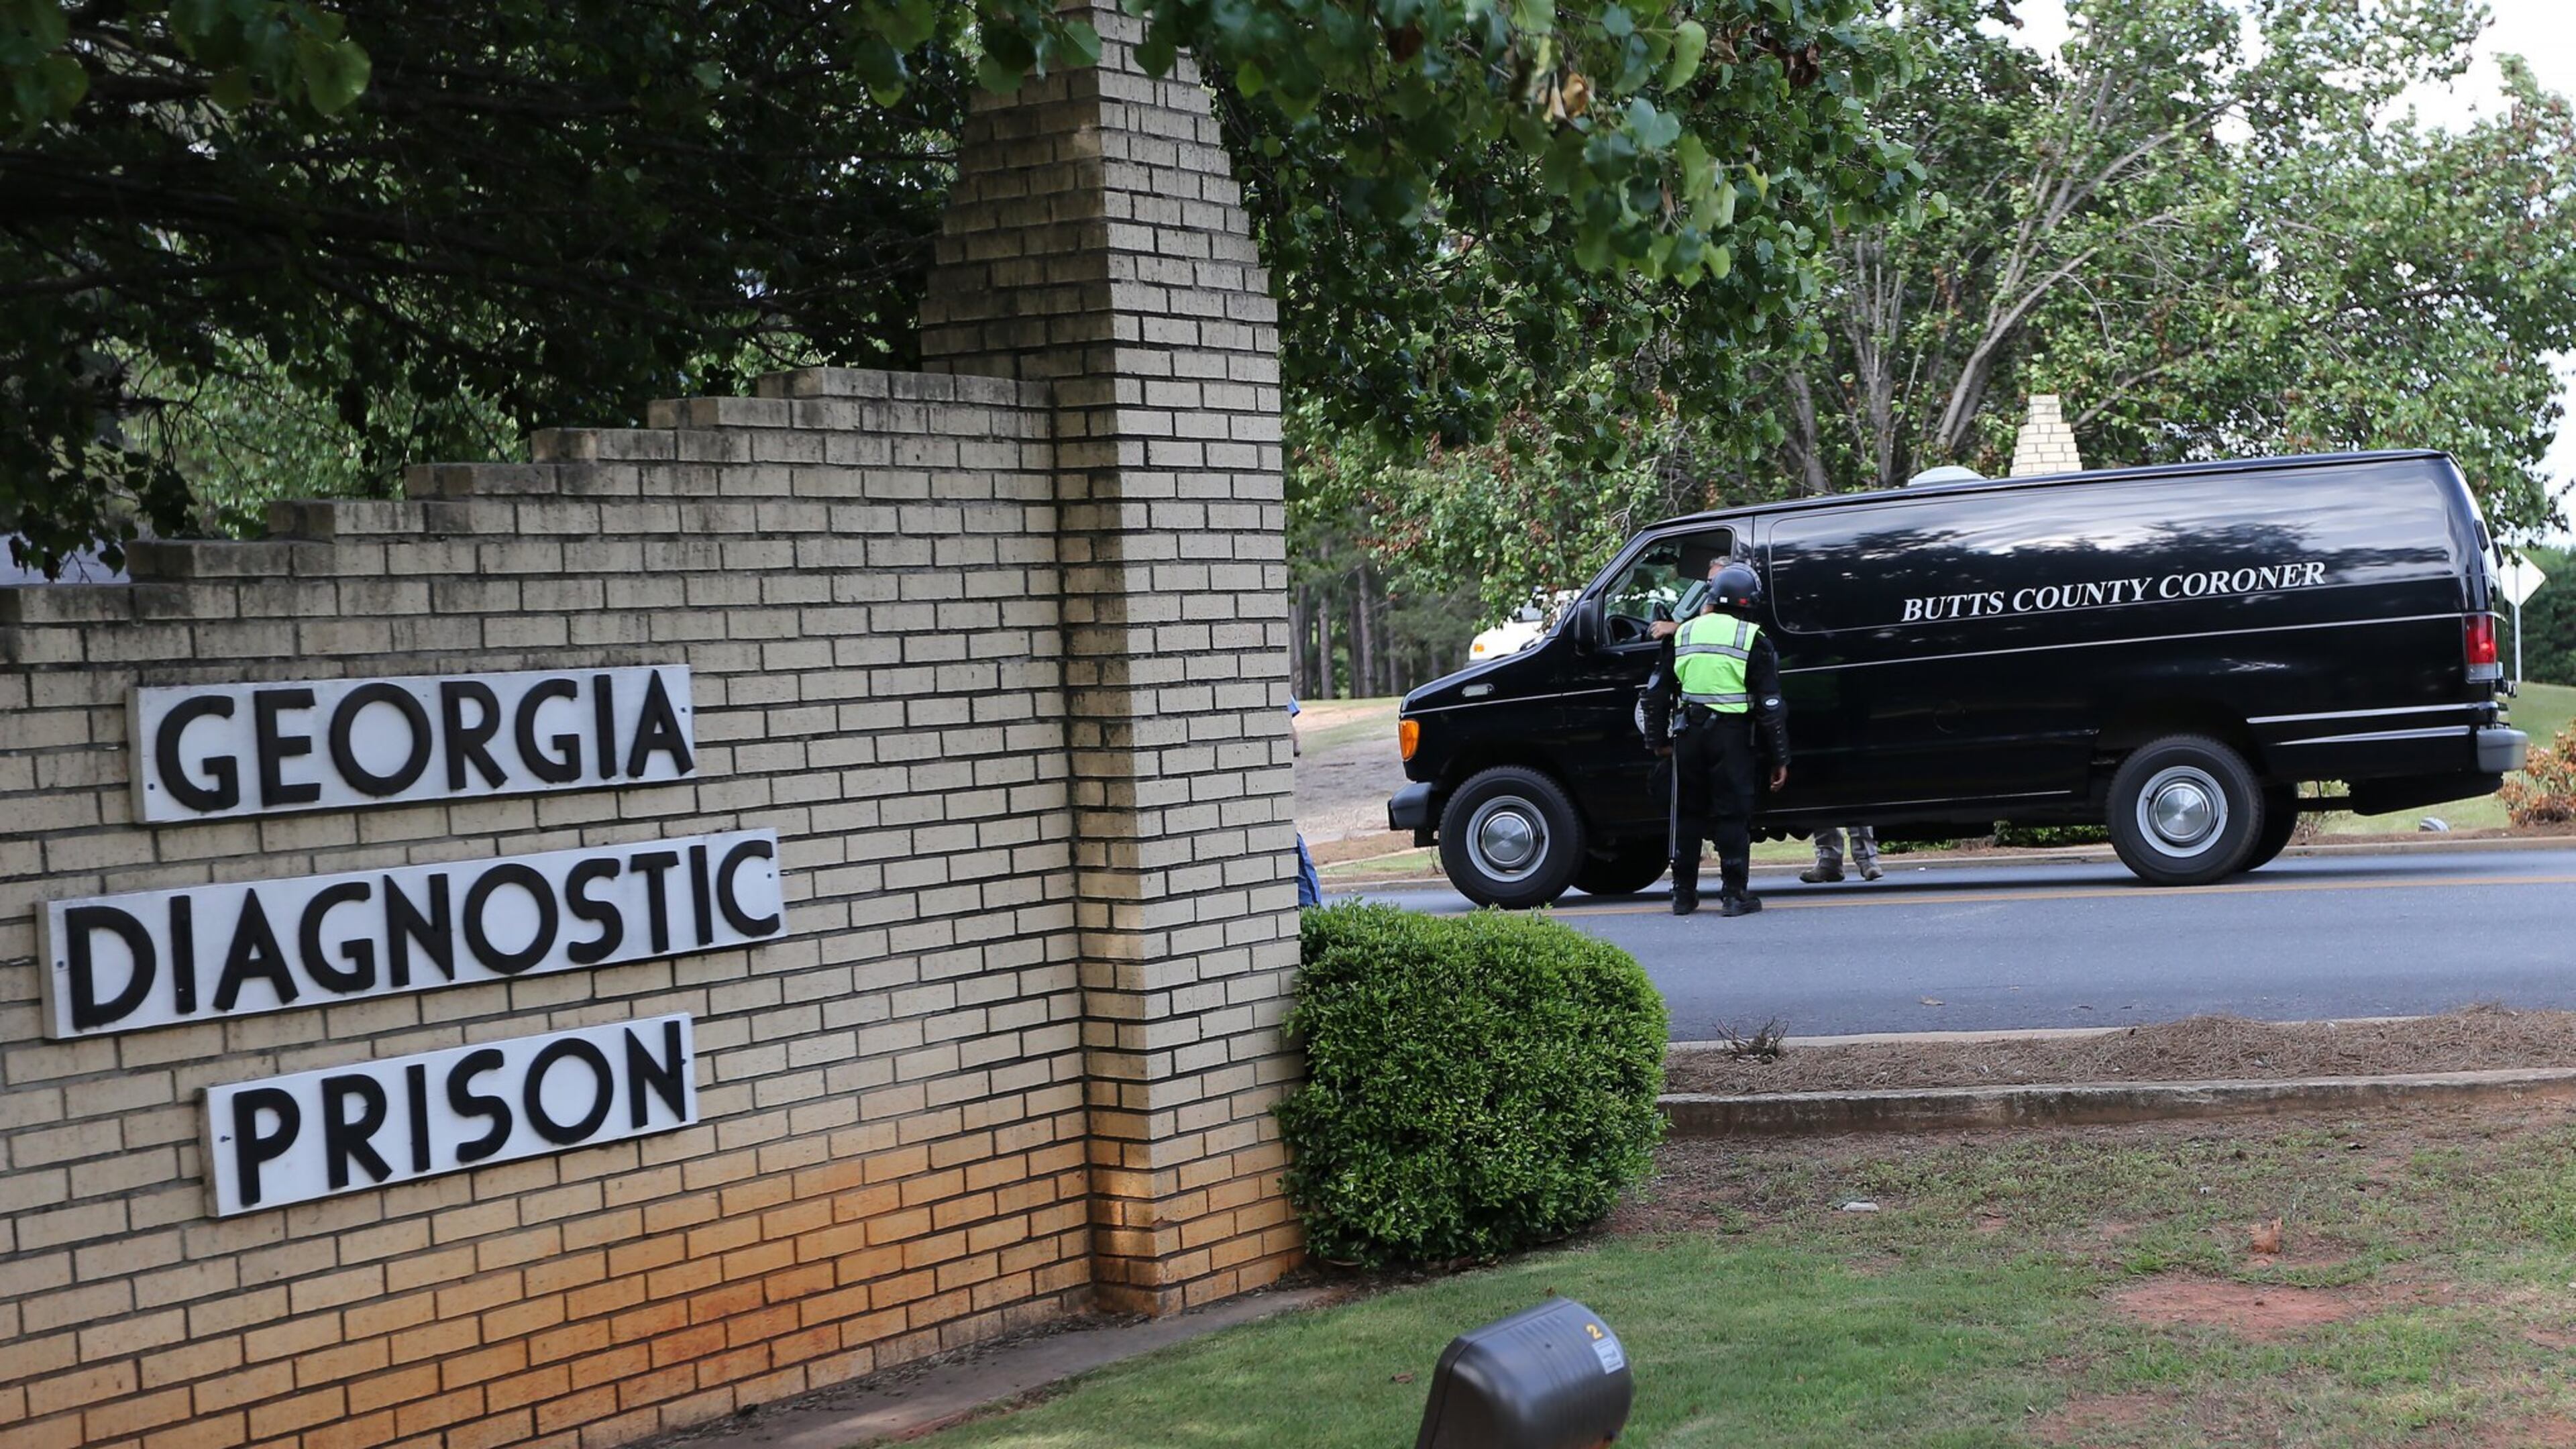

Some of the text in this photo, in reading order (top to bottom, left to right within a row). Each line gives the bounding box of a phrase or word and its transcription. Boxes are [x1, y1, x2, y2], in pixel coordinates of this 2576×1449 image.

[1901, 561, 2326, 622] BUTTS COUNTY CORONER
[155, 669, 694, 812] GEORGIA
[65, 840, 780, 1030] DIAGNOSTIC
[233, 1020, 687, 1206] PRISON
[1585, 1323, 1603, 1340] 2
